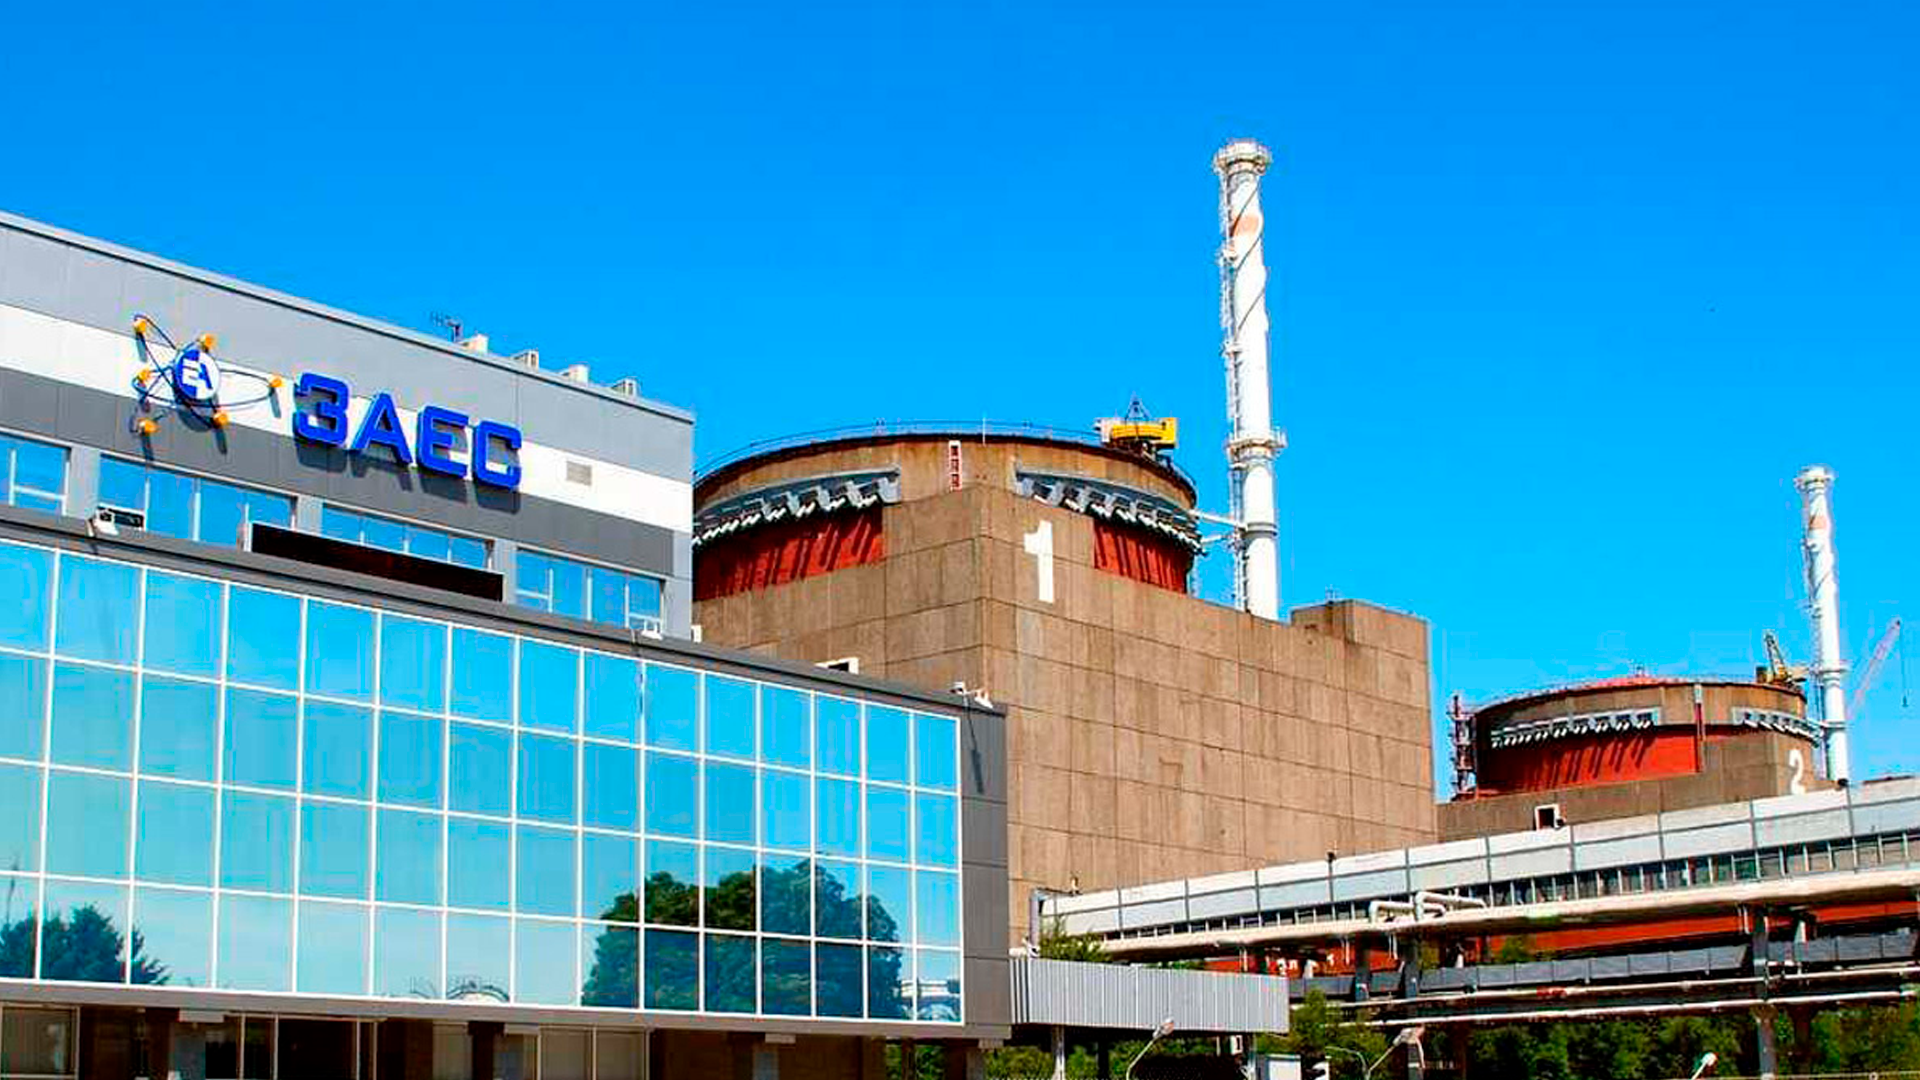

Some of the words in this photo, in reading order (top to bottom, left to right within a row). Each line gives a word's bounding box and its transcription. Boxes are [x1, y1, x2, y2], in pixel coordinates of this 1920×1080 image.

[293, 372, 522, 488] ЗАЕС
[1024, 520, 1054, 604] 1
[1789, 749, 1807, 796] 2
